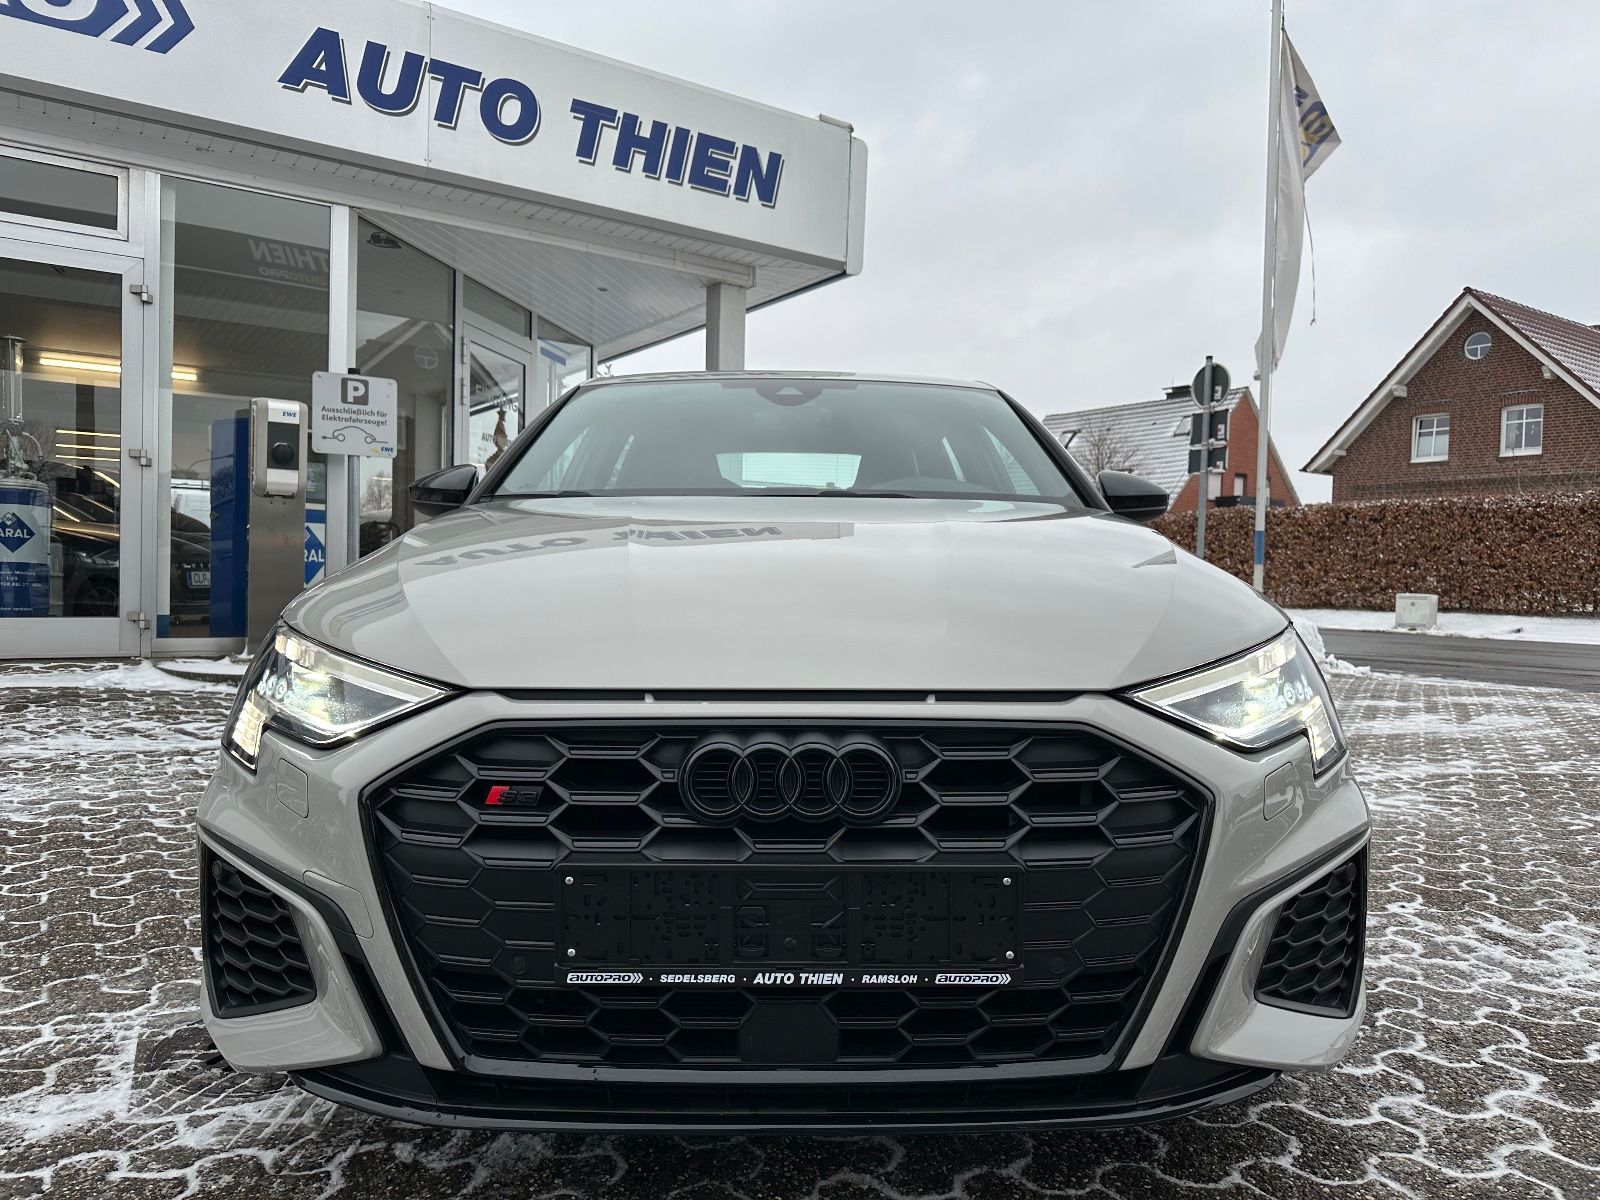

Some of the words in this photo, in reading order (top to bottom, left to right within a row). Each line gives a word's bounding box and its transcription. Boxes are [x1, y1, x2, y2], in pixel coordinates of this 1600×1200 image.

[278, 27, 541, 143] AUTO
[570, 98, 784, 208] THIEN
[347, 380, 365, 403] P
[321, 406, 376, 417] Ausschließlich
[376, 410, 388, 418] für
[321, 414, 388, 427] Elektrofahrzeuge!
[659, 974, 736, 983] SEDELSBERG
[753, 973, 795, 985] AUTO
[800, 973, 844, 985] THIEN
[861, 974, 918, 984] RAMSLOH
